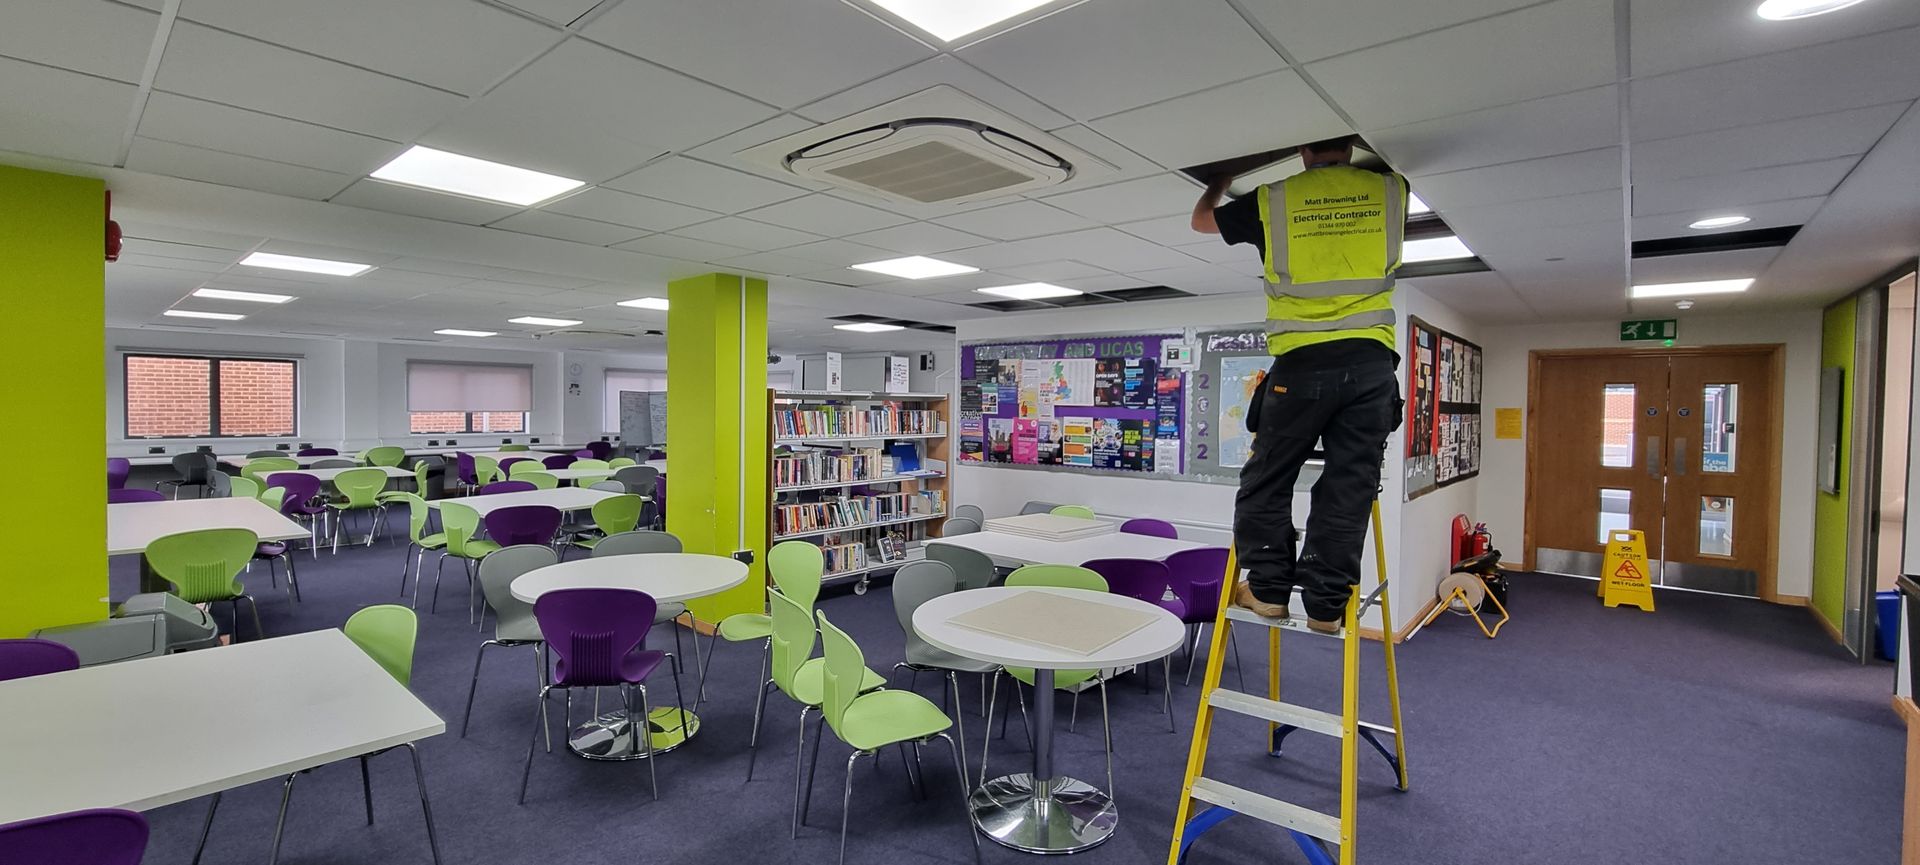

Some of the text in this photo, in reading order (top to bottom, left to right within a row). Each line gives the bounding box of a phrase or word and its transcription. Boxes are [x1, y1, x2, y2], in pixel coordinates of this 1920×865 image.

[1323, 195, 1357, 204] Browning
[1358, 194, 1369, 202] Ltd
[1293, 210, 1382, 224] Electrical Contractor
[1100, 341, 1144, 357] UCAS
